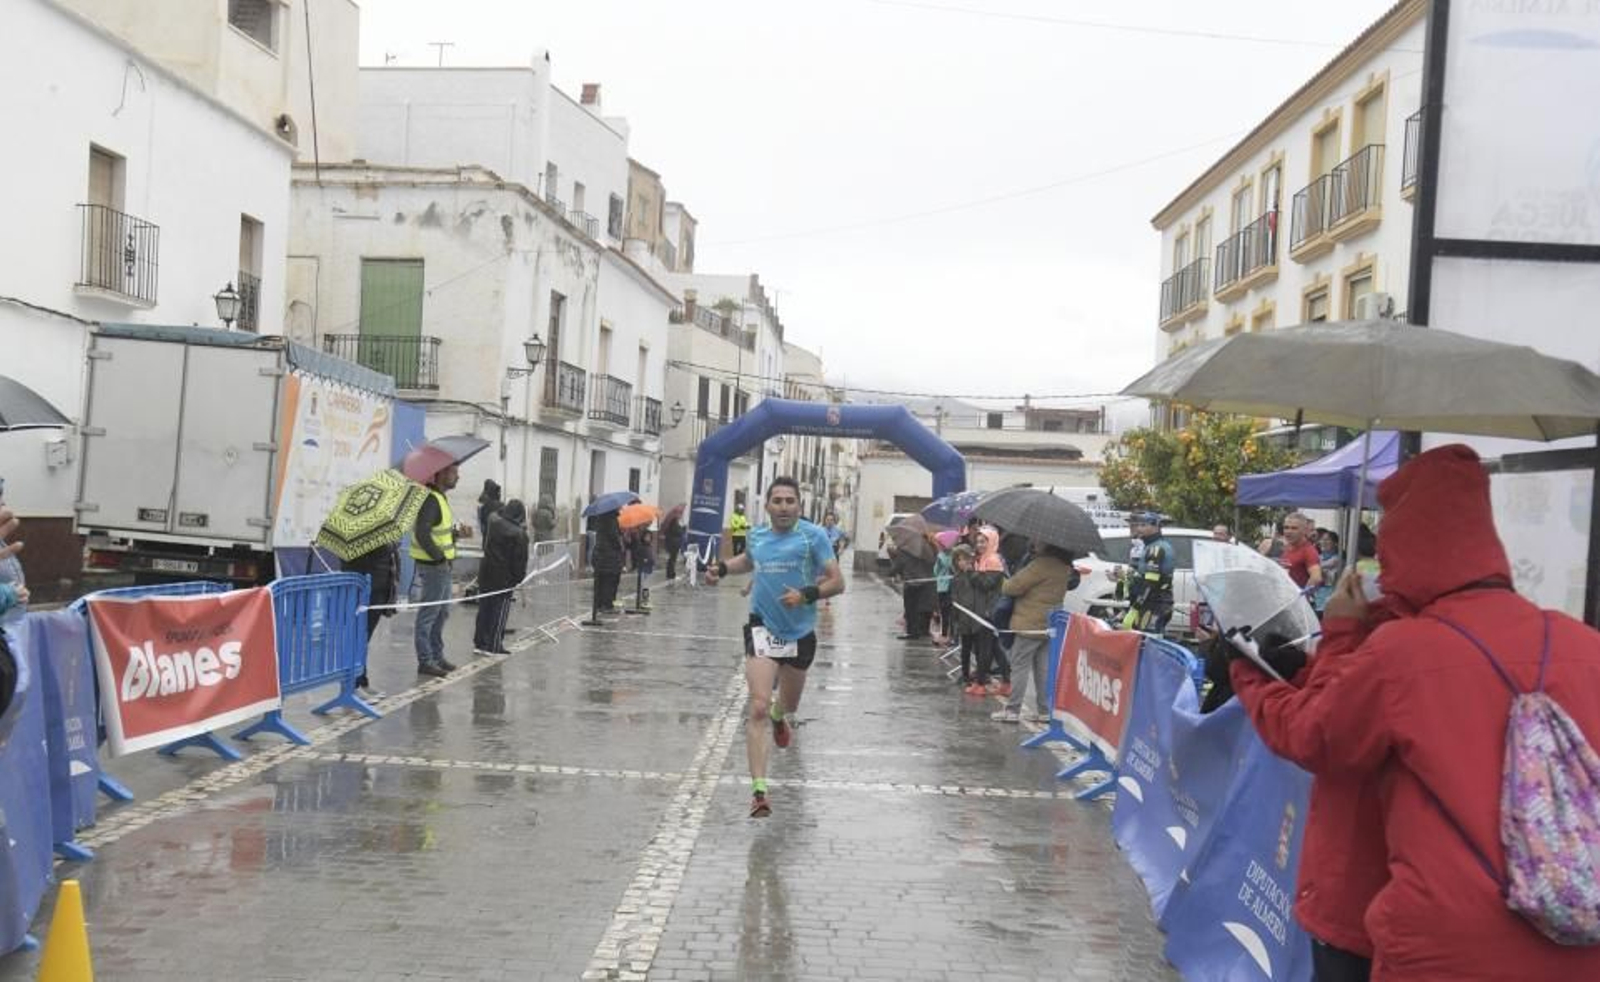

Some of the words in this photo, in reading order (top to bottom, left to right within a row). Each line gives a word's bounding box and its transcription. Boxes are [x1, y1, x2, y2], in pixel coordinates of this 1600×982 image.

[122, 640, 242, 702] Blanes
[1076, 649, 1122, 716] Blanes
[1238, 881, 1254, 906] DE
